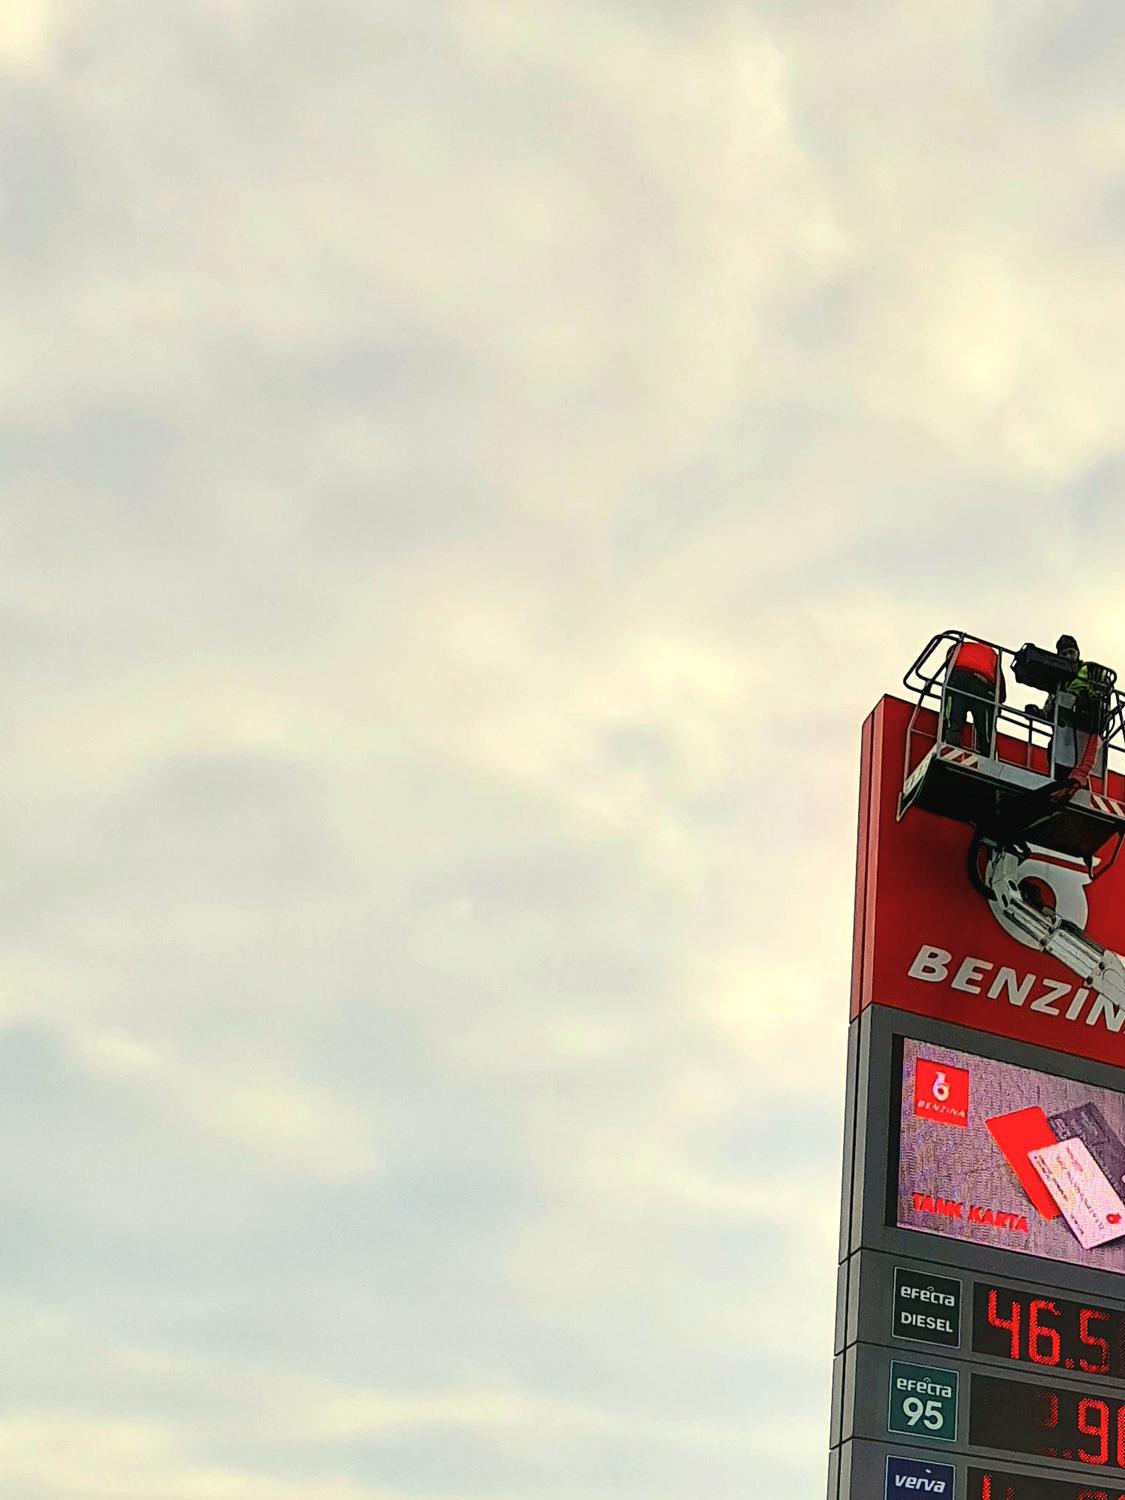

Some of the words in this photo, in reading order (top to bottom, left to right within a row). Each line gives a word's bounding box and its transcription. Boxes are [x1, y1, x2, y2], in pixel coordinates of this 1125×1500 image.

[912, 1191, 964, 1221] TANK
[967, 1204, 1029, 1235] KARTA
[900, 1311, 954, 1333] DIESEL
[902, 1397, 944, 1431] 95
[894, 1472, 946, 1494] verva
